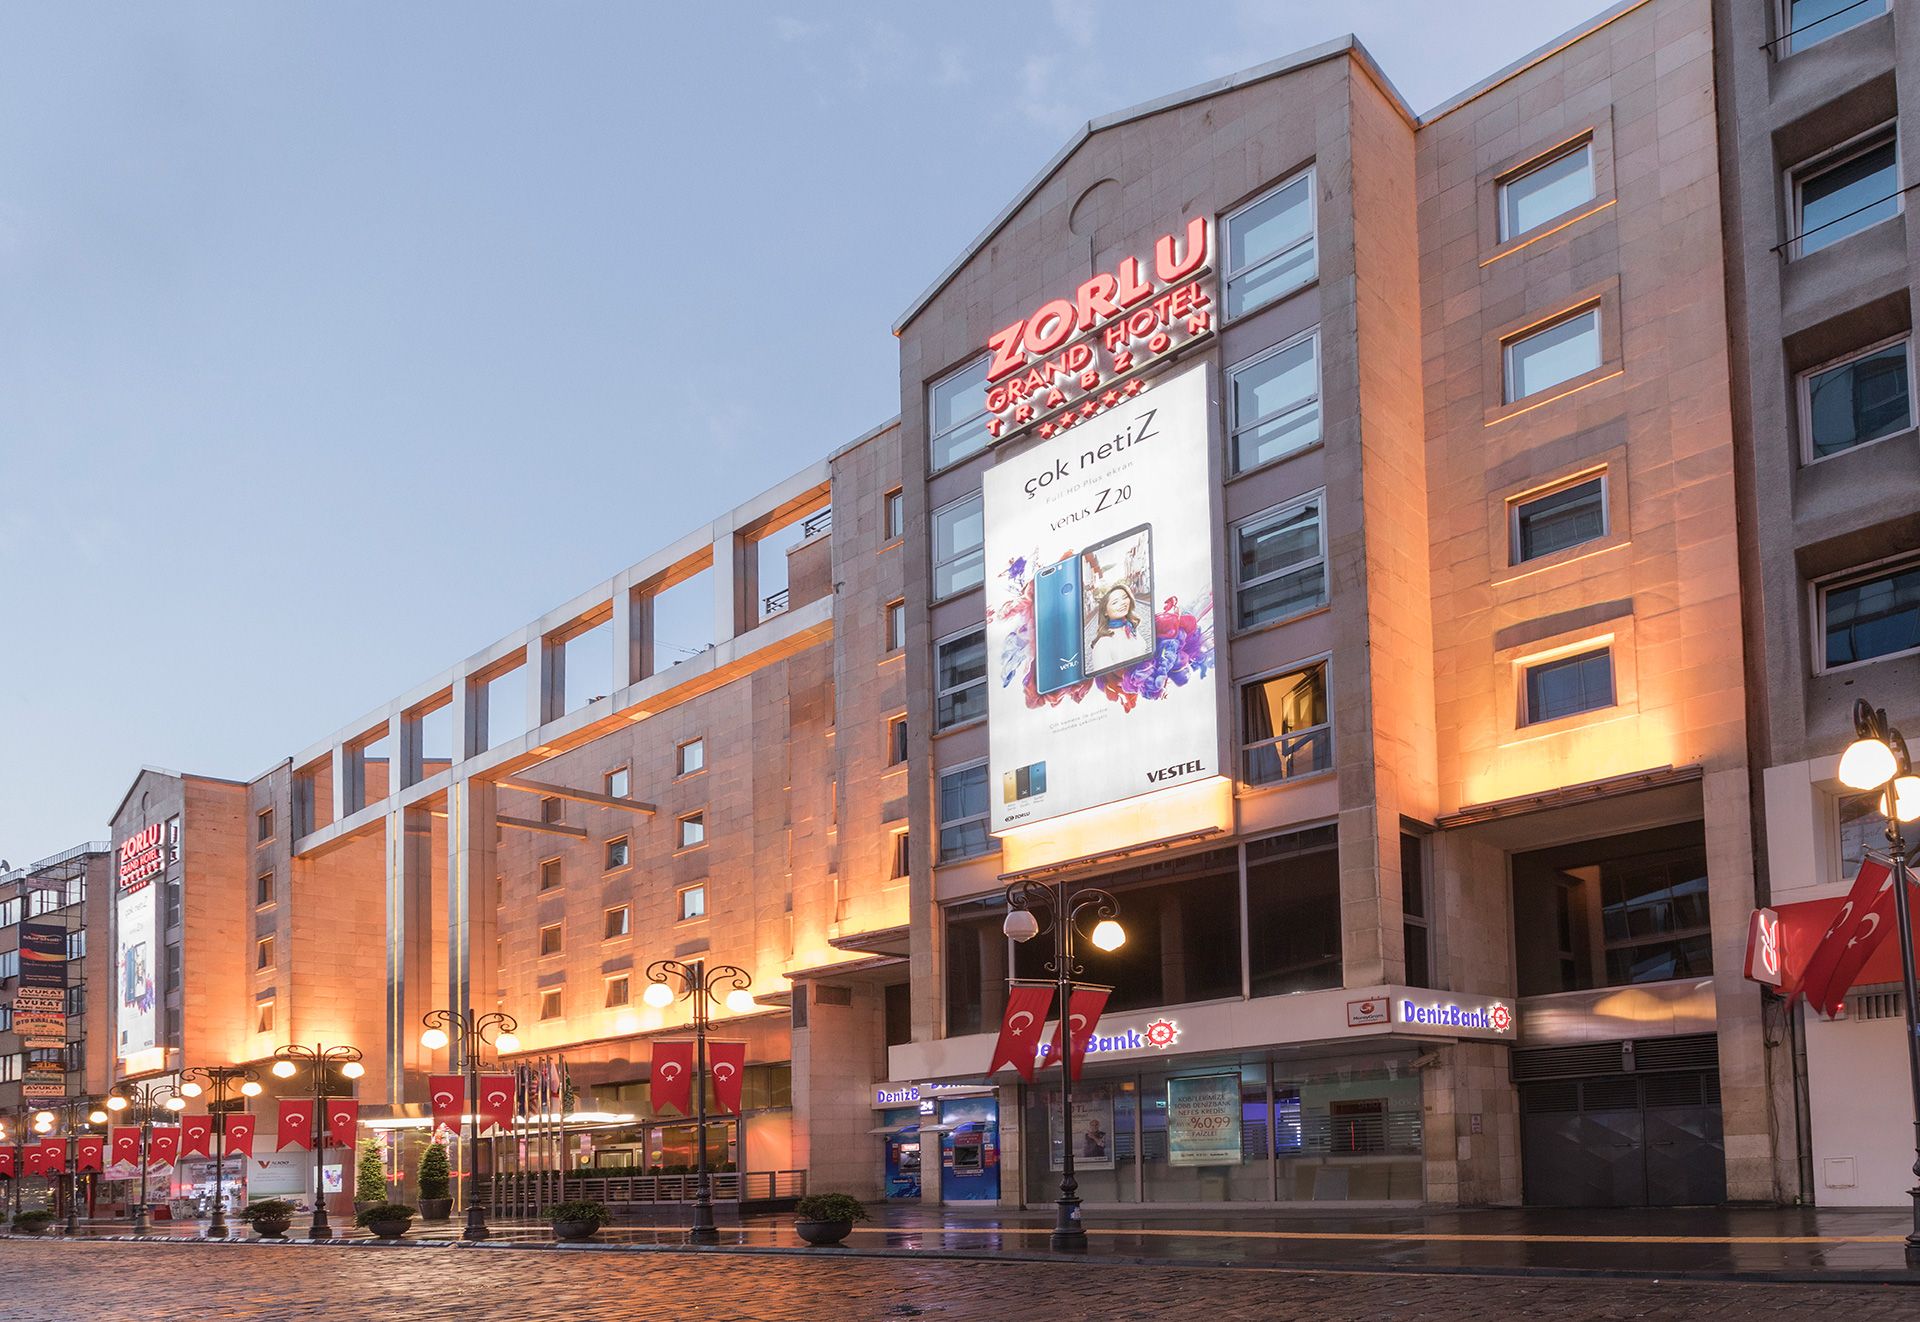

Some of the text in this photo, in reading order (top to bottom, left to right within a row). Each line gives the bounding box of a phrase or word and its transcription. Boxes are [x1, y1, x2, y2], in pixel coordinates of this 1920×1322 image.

[987, 216, 1208, 383] ZORLU
[986, 281, 1211, 414] GRAND HOTEL
[986, 310, 1211, 438] TRABZON
[1024, 408, 1160, 499] çok netiZ
[1050, 507, 1092, 532] venus
[1146, 759, 1206, 784] VESTEL
[121, 823, 161, 863] ZORLU
[15, 999, 60, 1007] AVUKAT
[20, 988, 62, 996] AVUKAT
[1404, 1000, 1489, 1028] DenizBank
[1033, 1029, 1141, 1057] eBank
[877, 1087, 920, 1104] DenizB
[920, 1100, 934, 1110] 24
